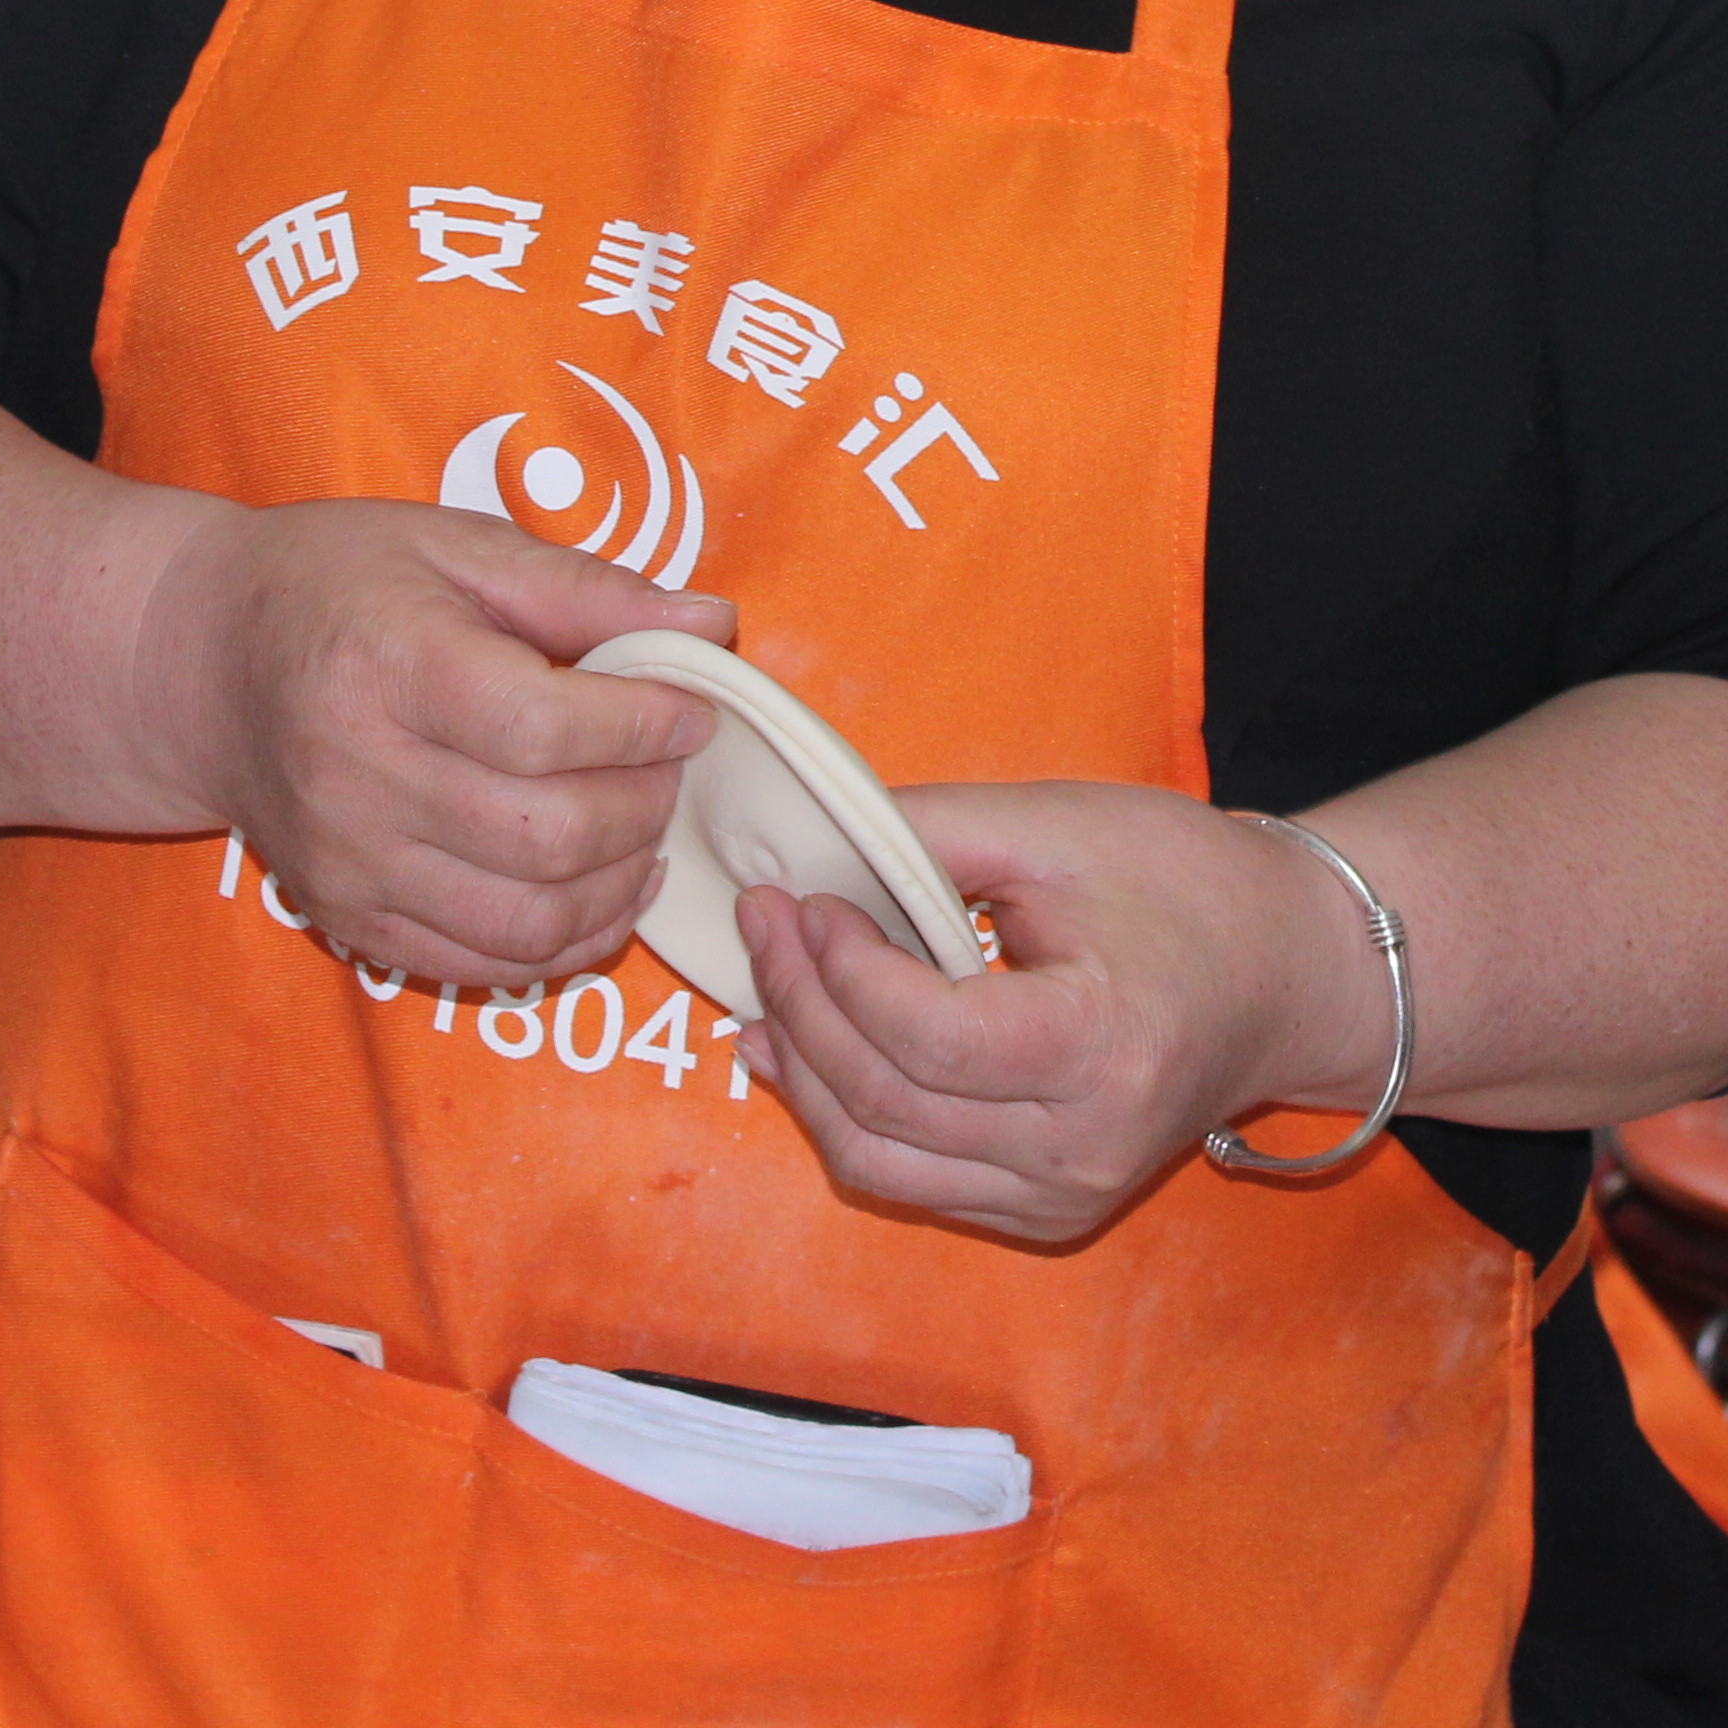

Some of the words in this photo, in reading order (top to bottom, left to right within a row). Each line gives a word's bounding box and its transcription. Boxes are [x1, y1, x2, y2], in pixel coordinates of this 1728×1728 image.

[236, 185, 1000, 530] 西安美食汇
